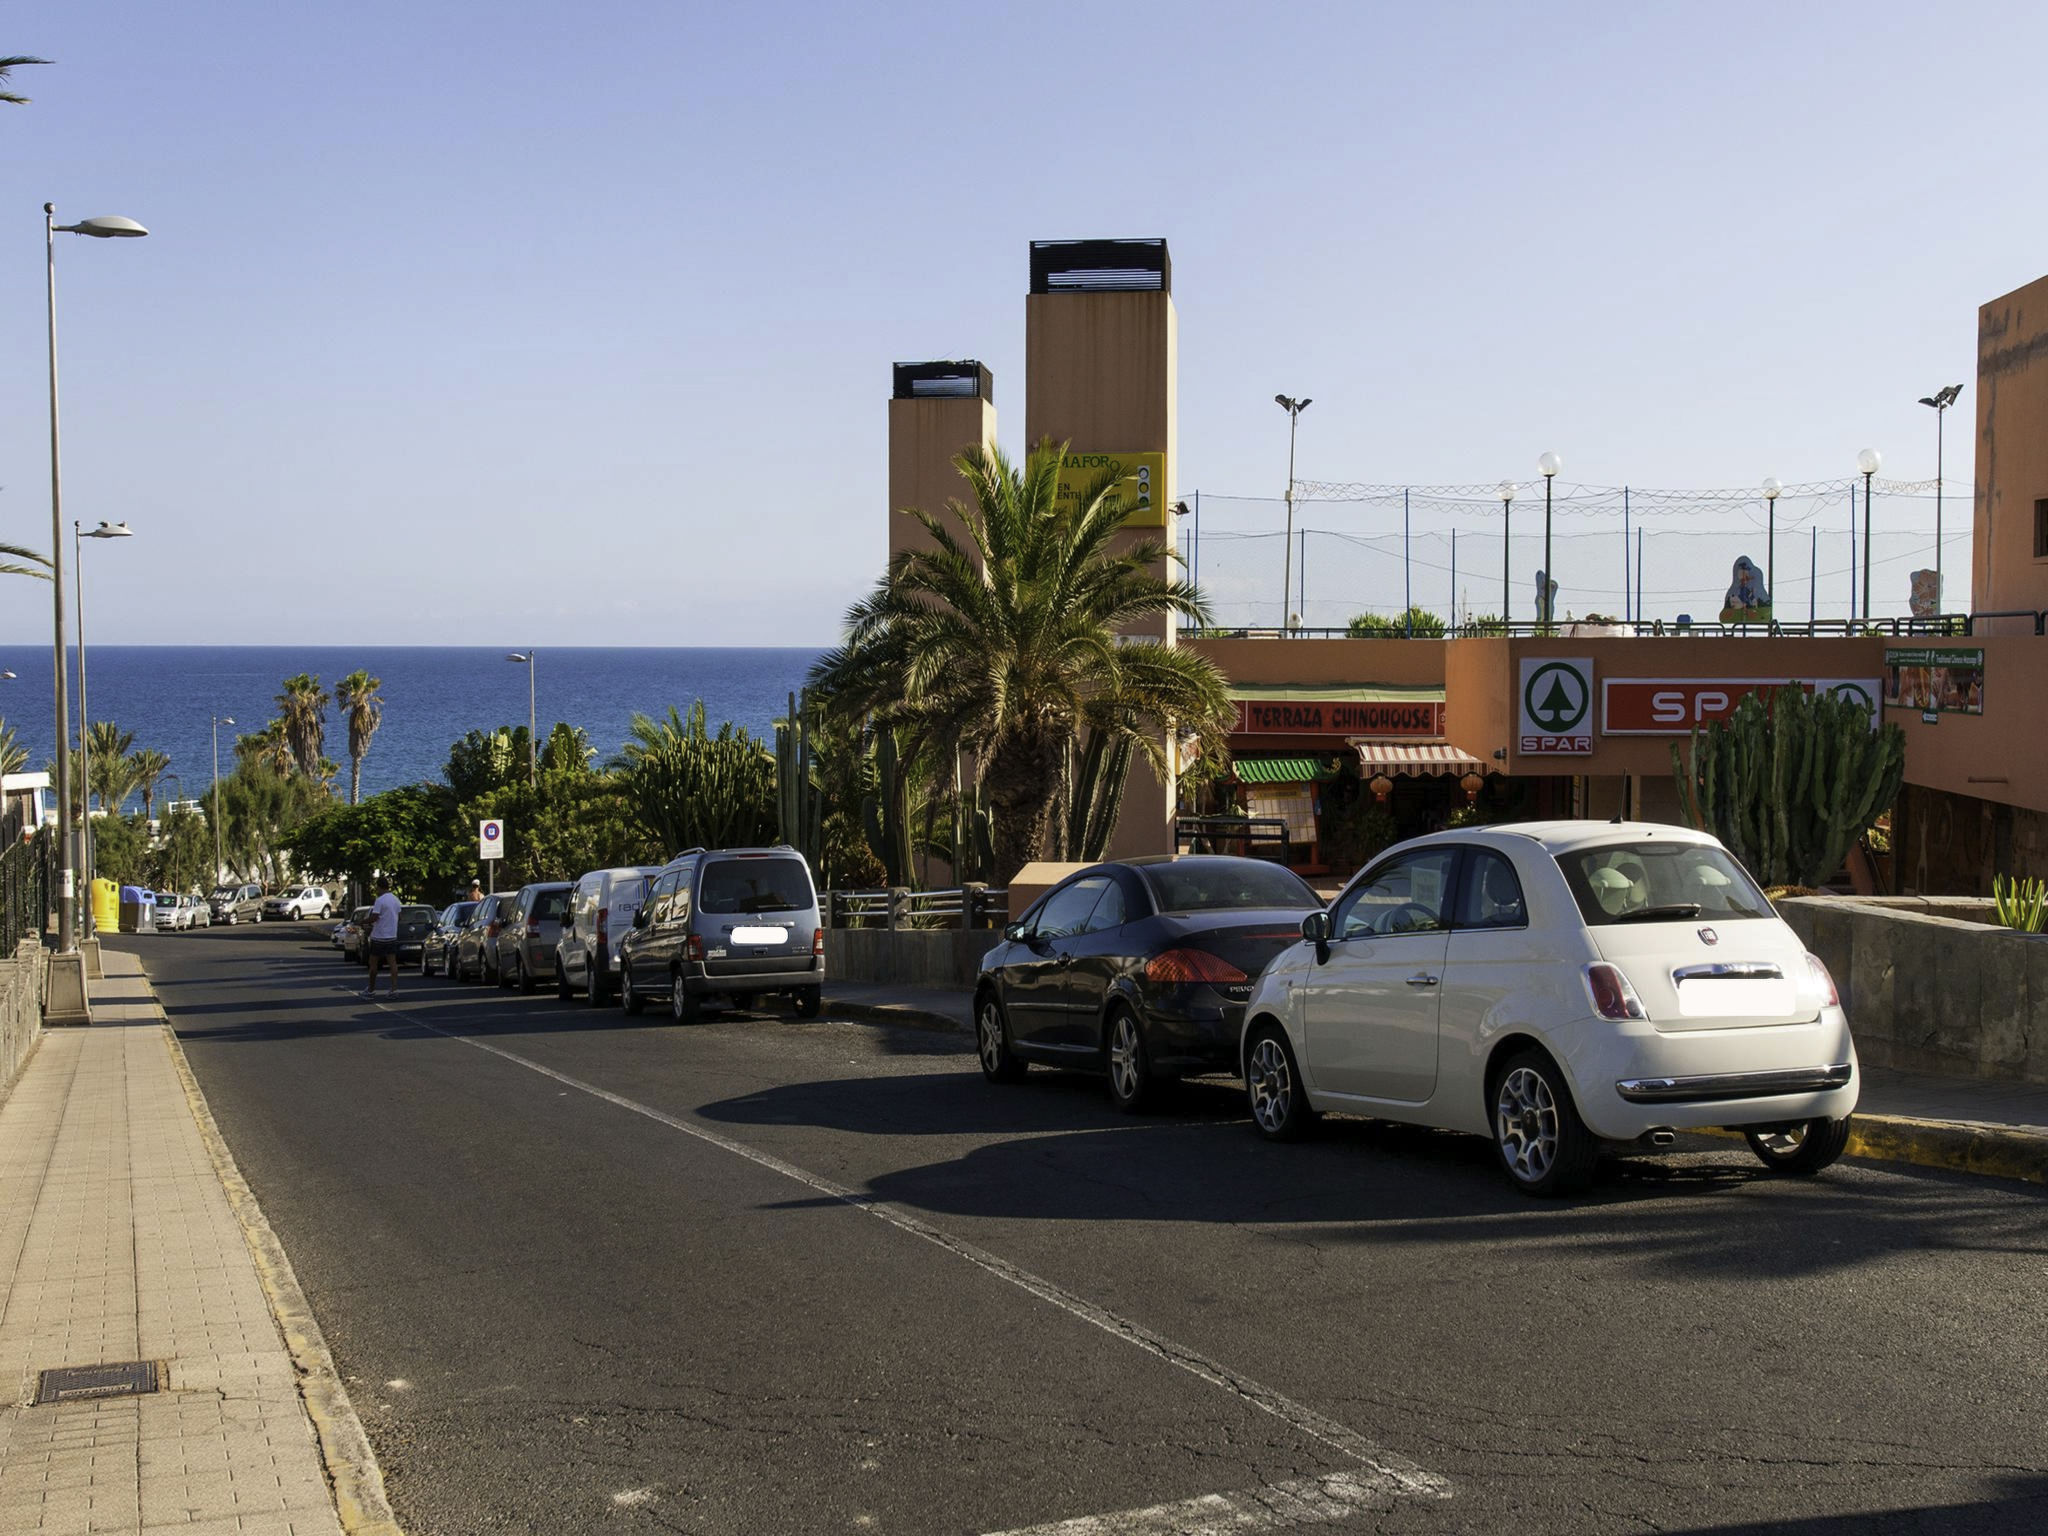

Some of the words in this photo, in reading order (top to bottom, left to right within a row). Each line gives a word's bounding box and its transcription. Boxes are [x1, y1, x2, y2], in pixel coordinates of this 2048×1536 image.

[1062, 456, 1120, 472] MAFORO
[1252, 707, 1322, 729] TERRAZA
[1332, 707, 1431, 729] CHINOHOUSE
[1522, 737, 1591, 751] SPAR
[618, 901, 640, 912] rad
